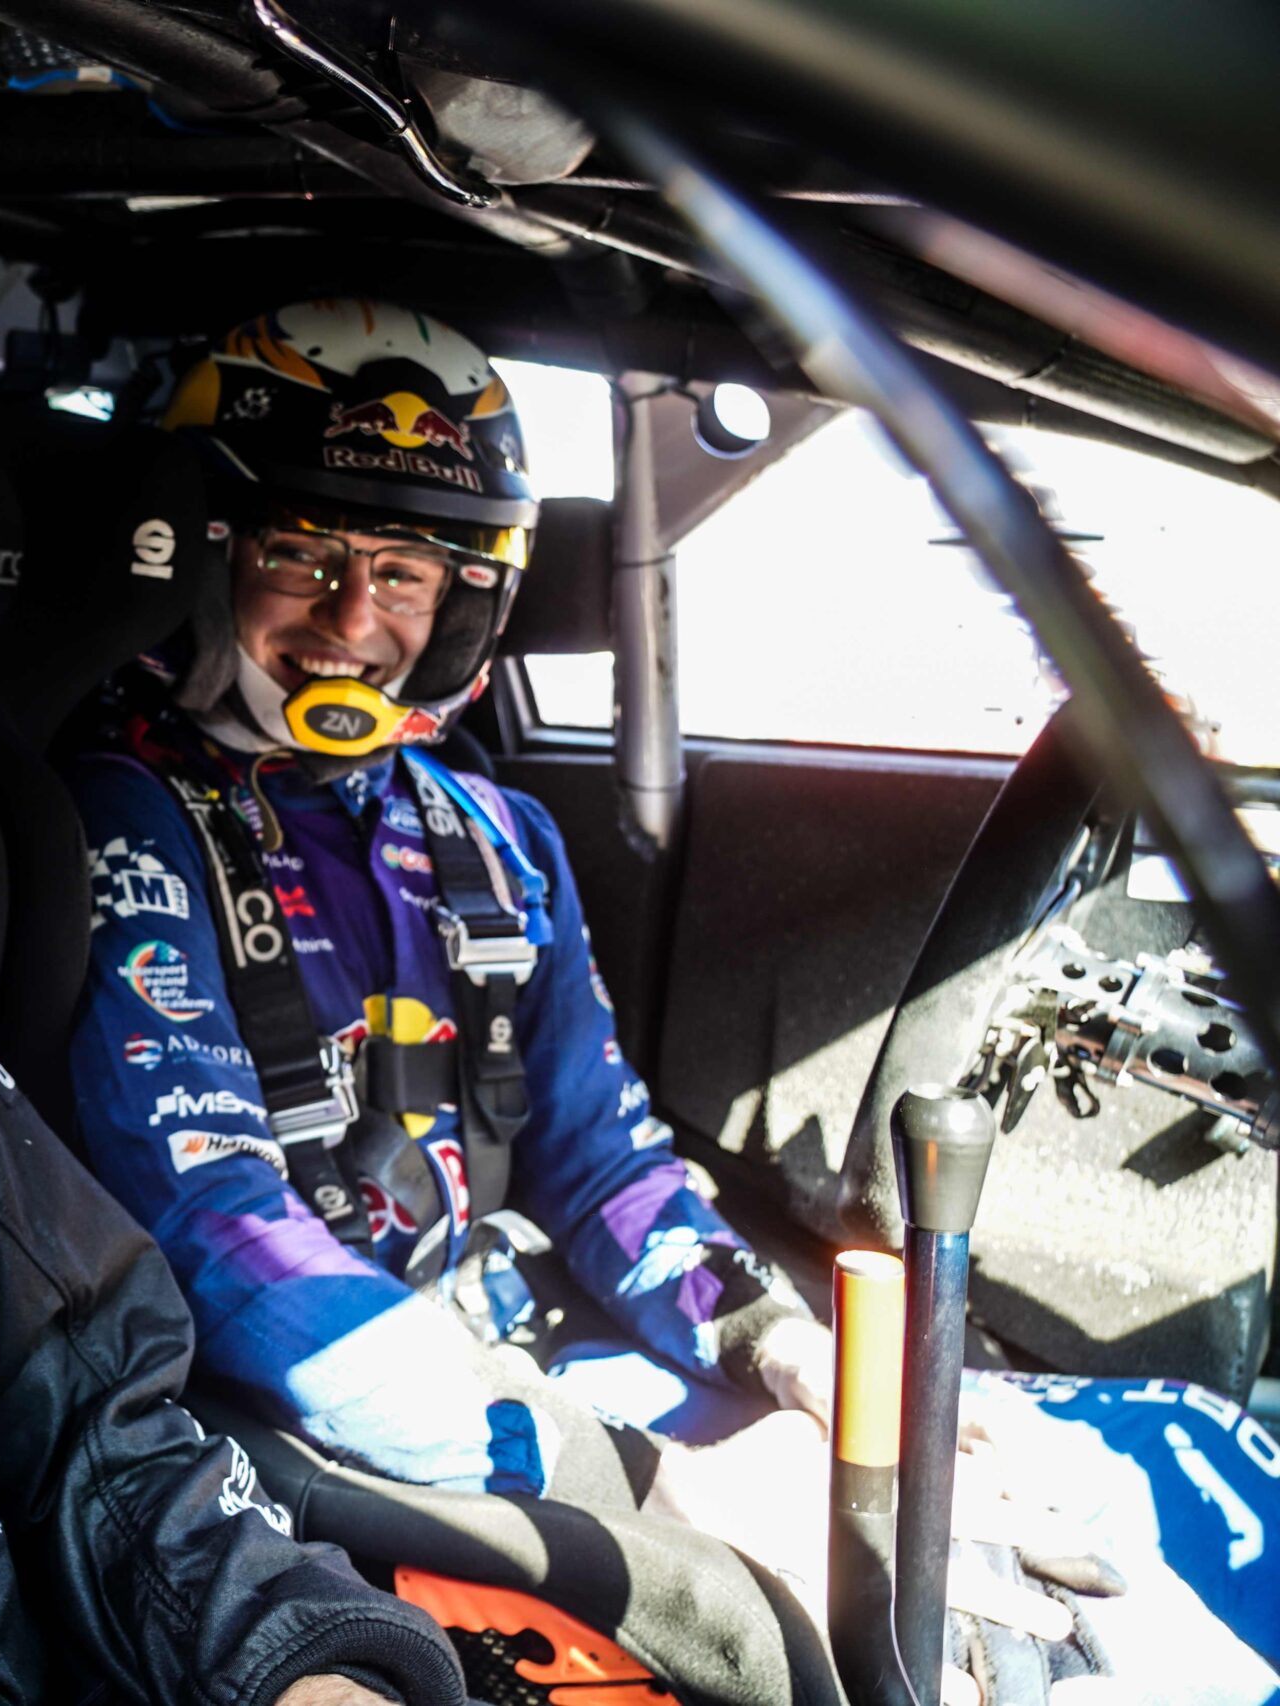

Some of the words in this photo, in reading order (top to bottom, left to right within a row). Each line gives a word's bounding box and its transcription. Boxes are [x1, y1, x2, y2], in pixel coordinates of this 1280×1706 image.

[324, 447, 406, 472] Red
[408, 453, 483, 493] Bull
[321, 710, 361, 738] ZN
